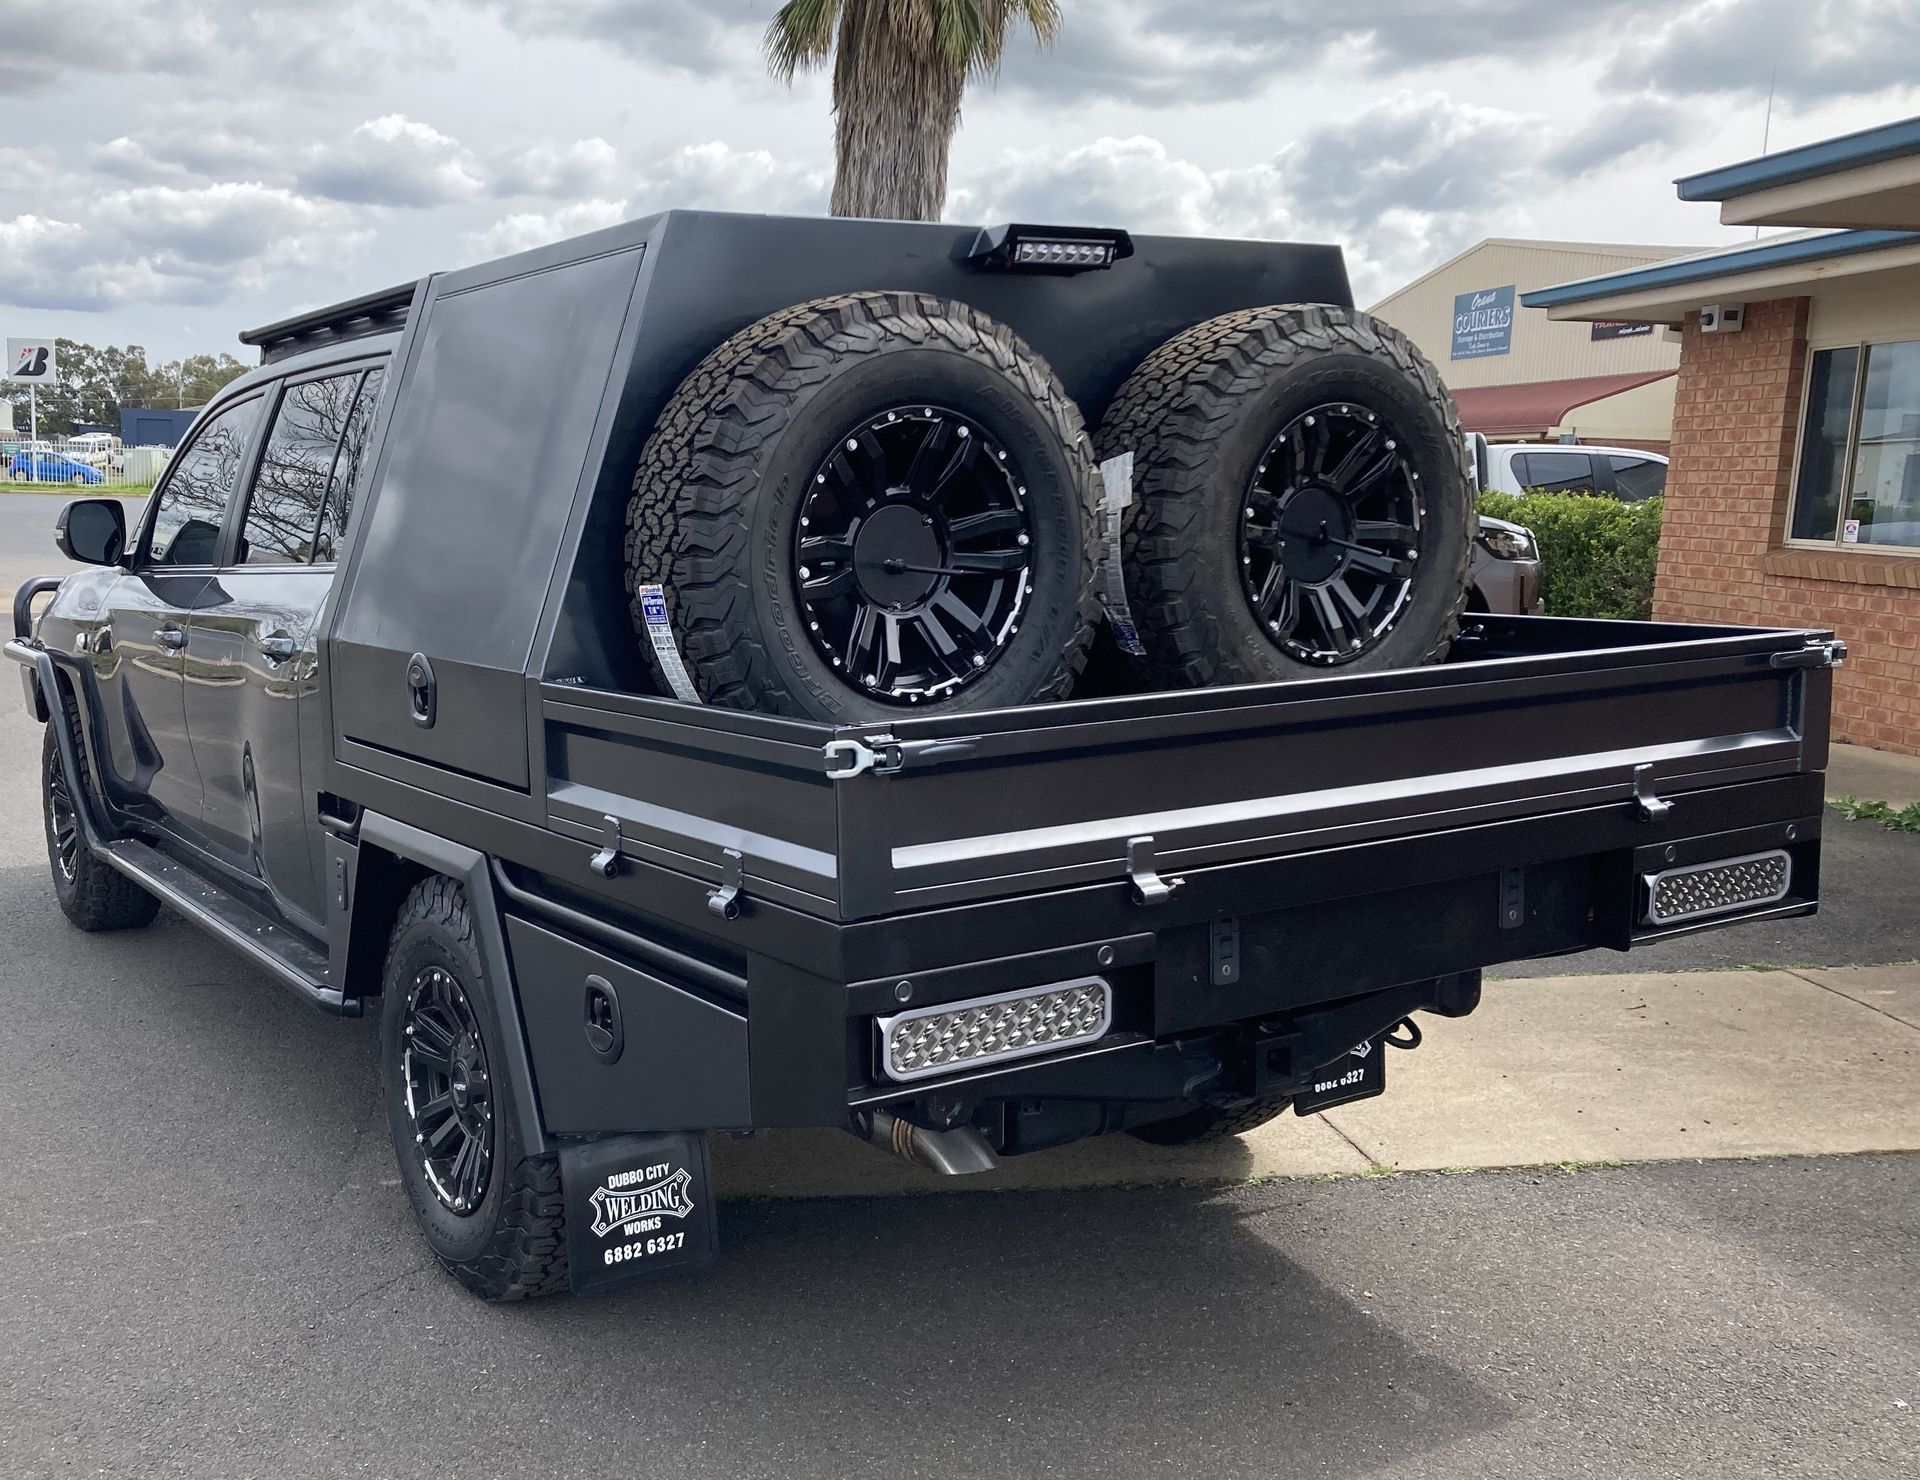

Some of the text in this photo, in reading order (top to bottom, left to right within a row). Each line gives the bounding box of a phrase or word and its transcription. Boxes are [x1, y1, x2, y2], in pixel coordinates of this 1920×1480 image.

[1455, 305, 1511, 334] COURIERS
[608, 1162, 670, 1189] DUBBO CITY
[605, 1181, 680, 1224] WELDING
[623, 1216, 662, 1237] WORKS
[604, 1232, 685, 1265] 6882 6327
